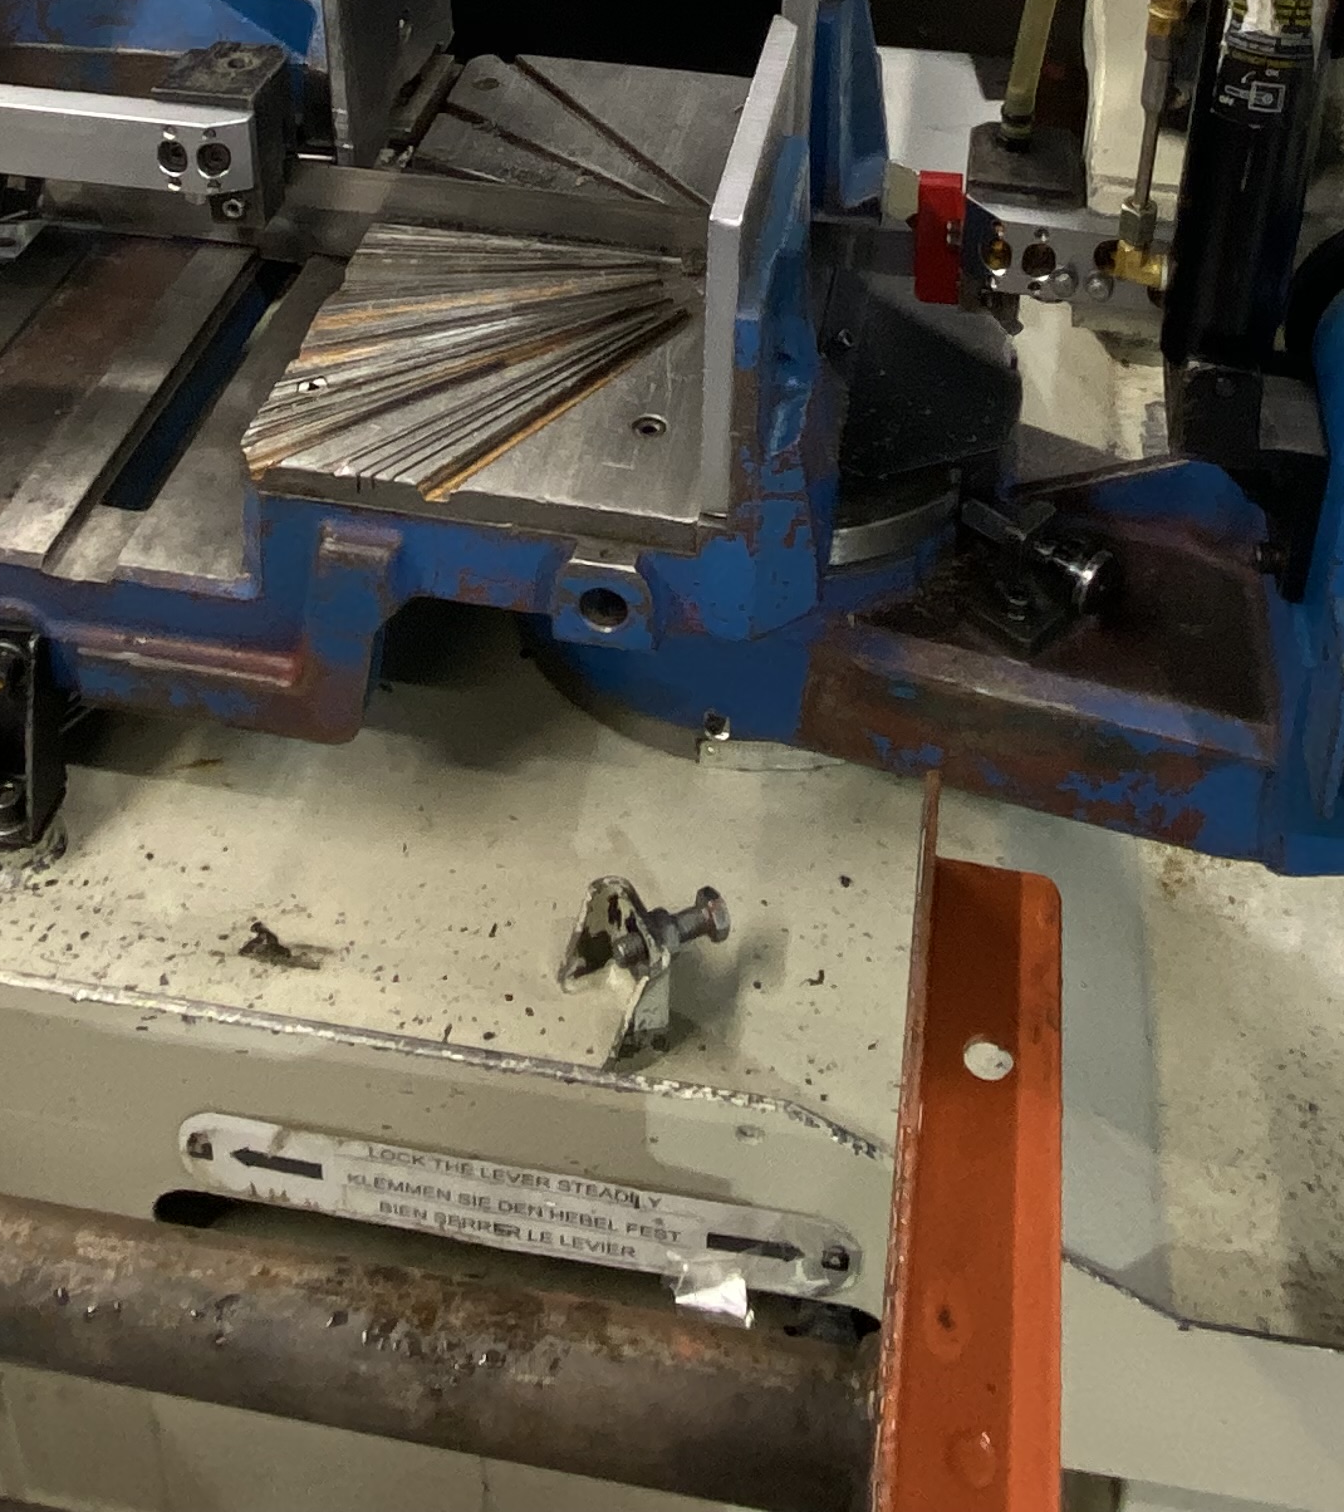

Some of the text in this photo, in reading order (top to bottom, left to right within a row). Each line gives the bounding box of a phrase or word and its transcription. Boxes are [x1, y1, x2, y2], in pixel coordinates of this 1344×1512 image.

[368, 1146, 428, 1166] LOCK
[433, 1157, 470, 1177] THE
[480, 1167, 551, 1189] LEVER
[347, 1173, 682, 1242] KLEMMEN SIE DEN HEBEL FEST
[379, 1201, 428, 1220] BIEN
[528, 1230, 553, 1243] LE
[560, 1233, 636, 1258] LEVIER
